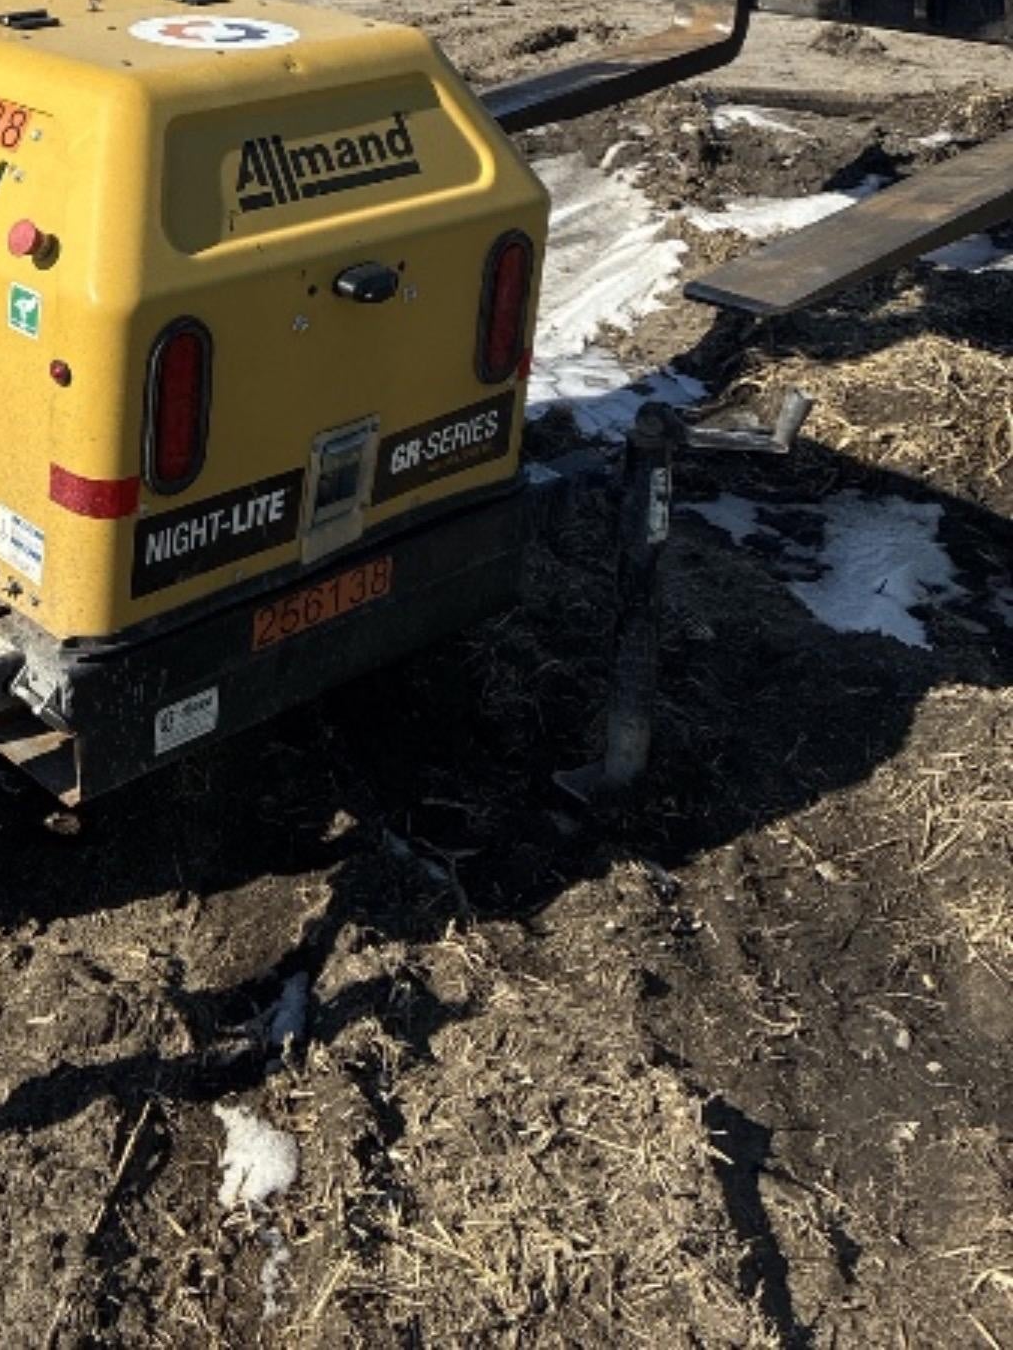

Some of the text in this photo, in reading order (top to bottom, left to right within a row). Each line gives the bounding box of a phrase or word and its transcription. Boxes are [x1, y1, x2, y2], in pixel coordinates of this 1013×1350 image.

[236, 111, 415, 204] Allmand
[390, 410, 499, 475] GR-SERIES
[145, 488, 286, 566] NIGHT-LITE
[256, 559, 389, 646] 256138
